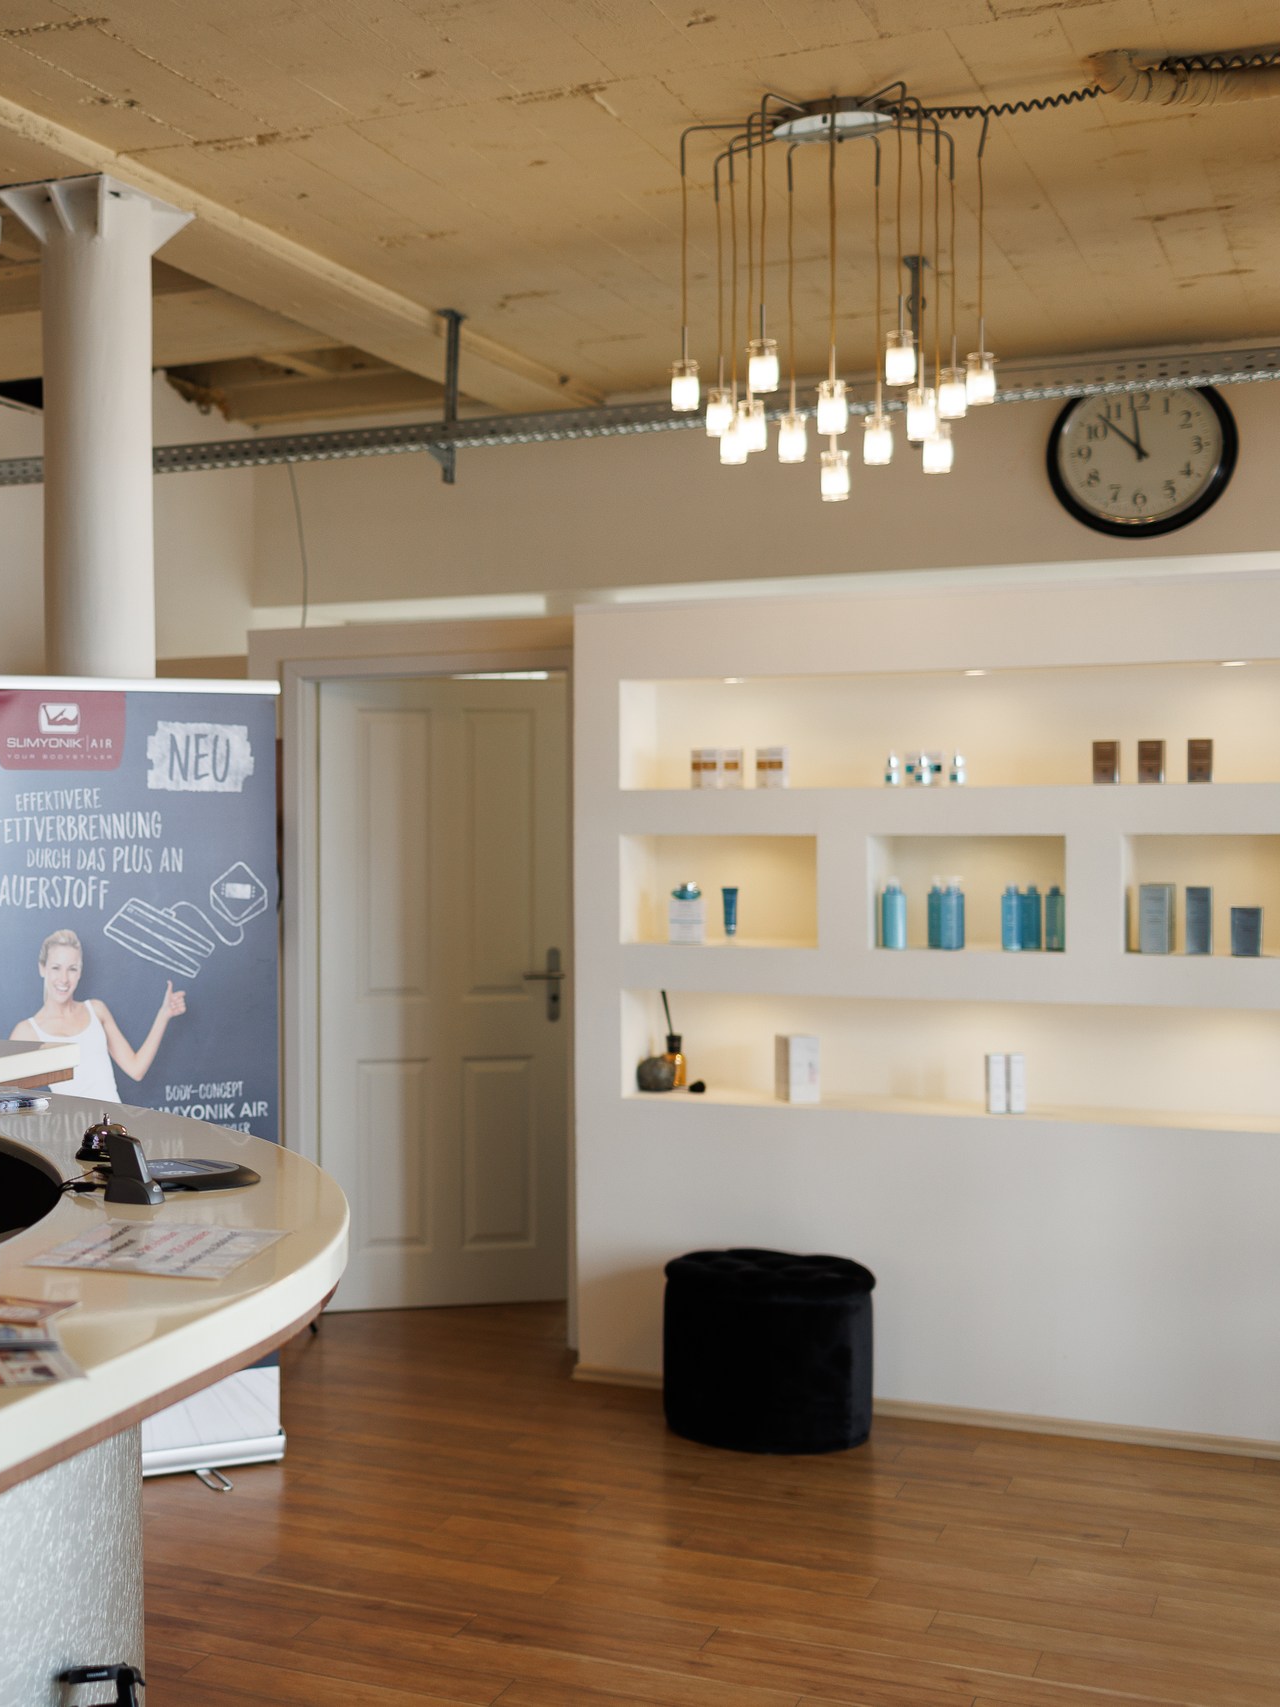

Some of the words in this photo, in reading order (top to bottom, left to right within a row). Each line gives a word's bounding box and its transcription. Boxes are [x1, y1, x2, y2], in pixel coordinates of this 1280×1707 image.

[1179, 410, 1193, 429] 2
[1087, 424, 1108, 440] 10
[1192, 435, 1203, 454] 3
[1078, 445, 1092, 464] 9
[1087, 468, 1100, 487] 8
[1178, 461, 1193, 478] 4
[1109, 484, 1121, 502] 7
[1163, 479, 1176, 496] 5
[6, 737, 82, 749] SLIMYONIK
[90, 738, 113, 749] AIR
[168, 733, 231, 783] NEU
[15, 787, 102, 812] EFFEKTIVERE
[26, 848, 70, 870] DURCH
[76, 847, 106, 873] DAS
[112, 844, 153, 874] PLUS
[159, 847, 184, 873] AN
[165, 1081, 244, 1102] BODY-CONCEPT
[239, 1100, 268, 1118] AIR
